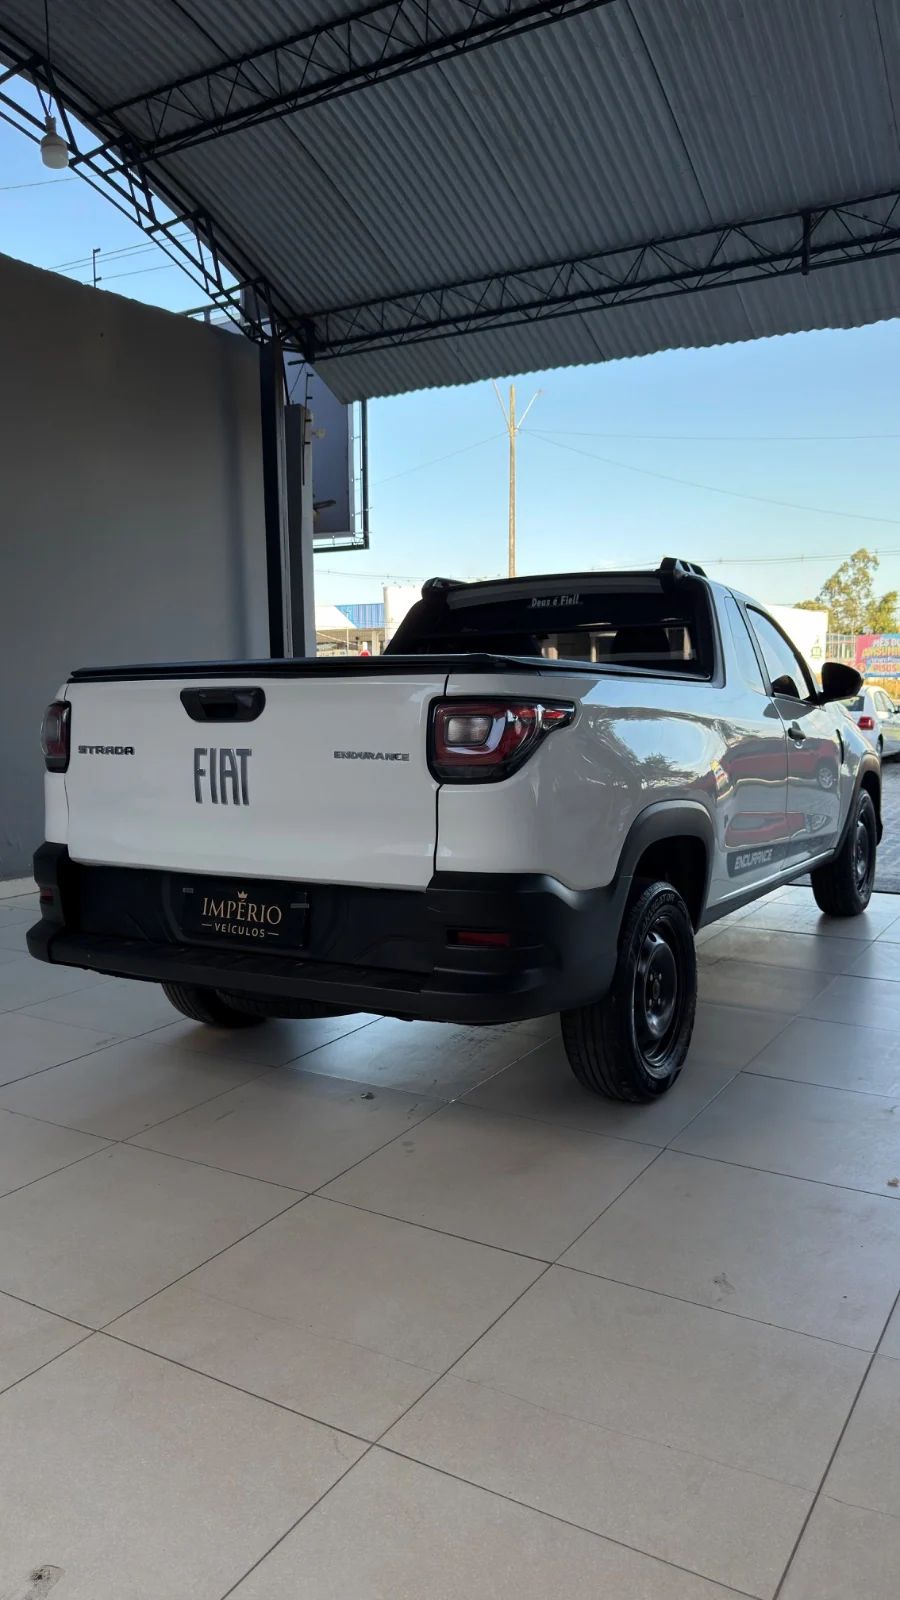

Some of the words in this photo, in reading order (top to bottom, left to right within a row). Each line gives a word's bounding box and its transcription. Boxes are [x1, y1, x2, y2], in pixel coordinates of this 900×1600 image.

[78, 745, 136, 756] STRADA
[333, 750, 410, 762] ENDURANCE
[194, 747, 253, 805] FIAT
[733, 848, 773, 870] ENDURANCE
[201, 896, 283, 925] IMPÉRIO
[214, 922, 266, 938] VEÍCULOS
